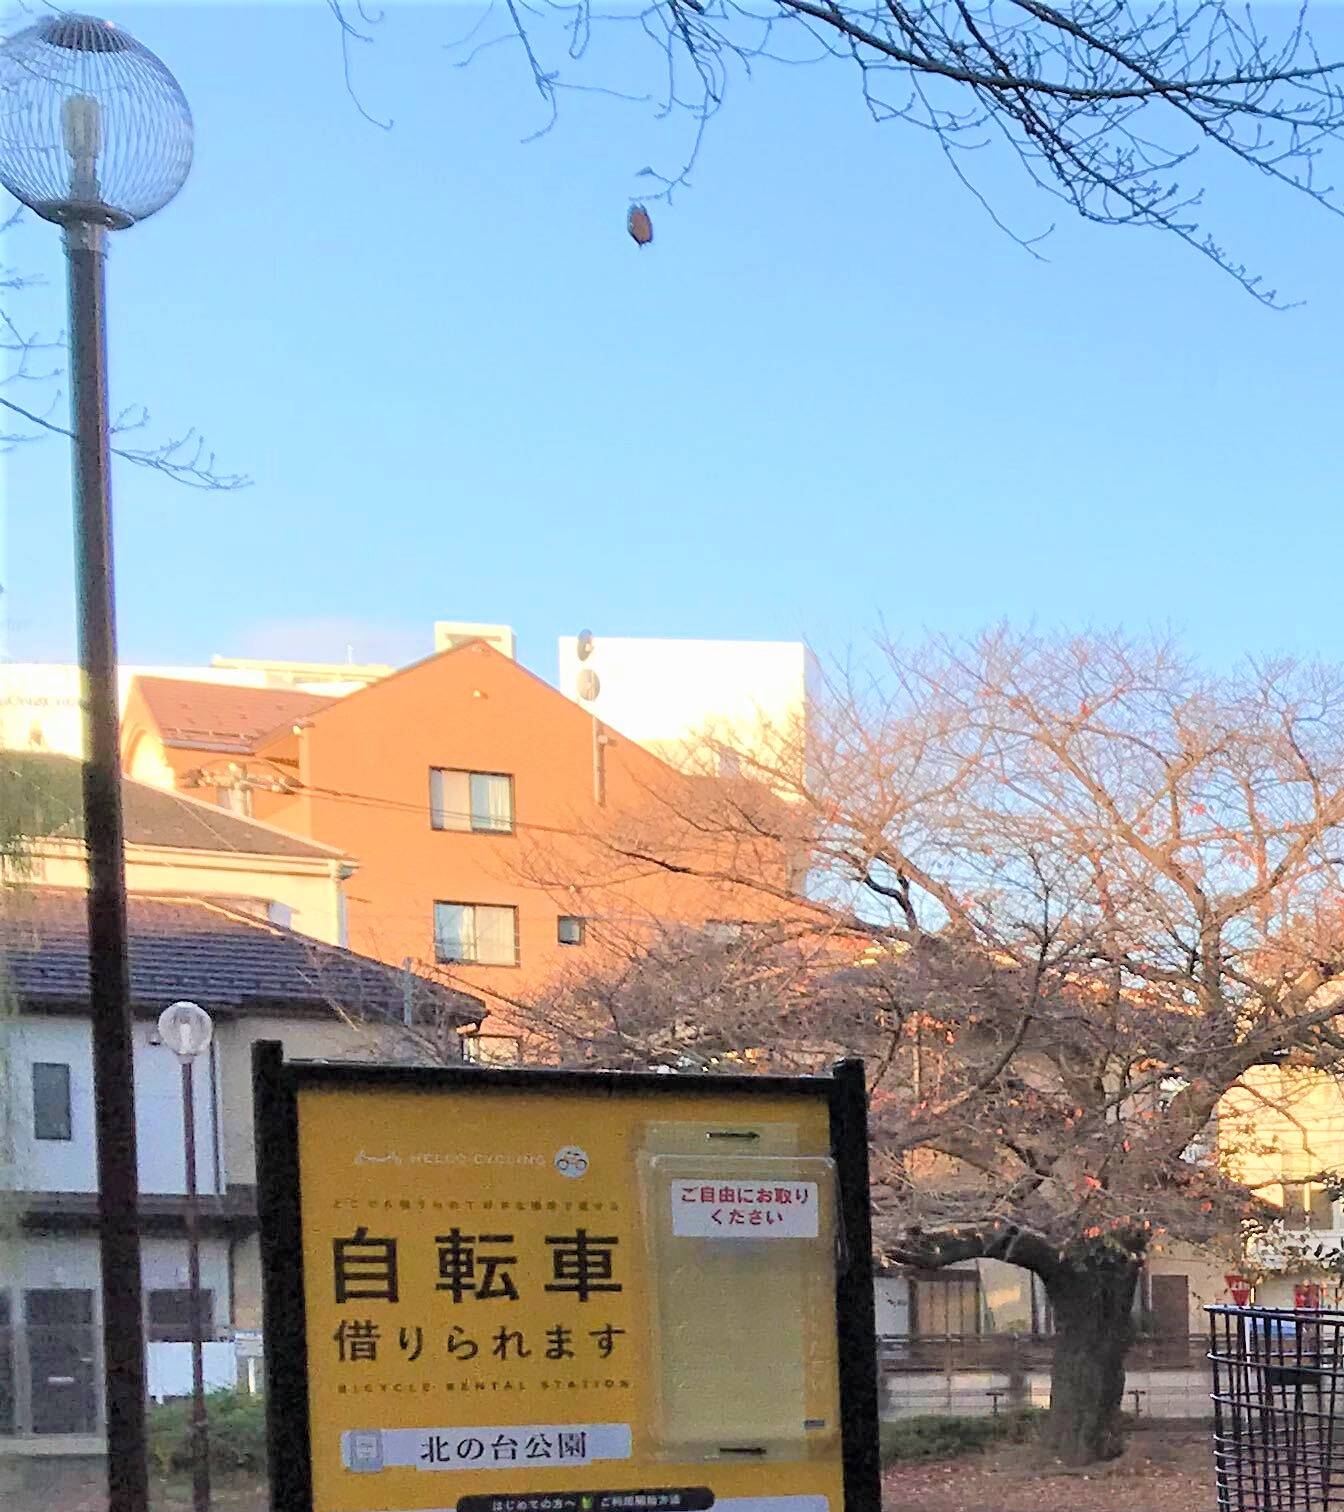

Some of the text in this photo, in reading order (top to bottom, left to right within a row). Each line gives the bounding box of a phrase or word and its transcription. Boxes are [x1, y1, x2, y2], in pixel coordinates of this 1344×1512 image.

[681, 1186, 809, 1204] ご自由にお取り
[710, 1208, 783, 1225] ください
[332, 1226, 623, 1303] 自転車
[333, 1319, 626, 1362] 借りられます
[338, 1379, 630, 1394] BICYCLE RENTAL STATION
[420, 1430, 587, 1463] 北の台公園
[492, 1498, 576, 1511] はじめての方へ
